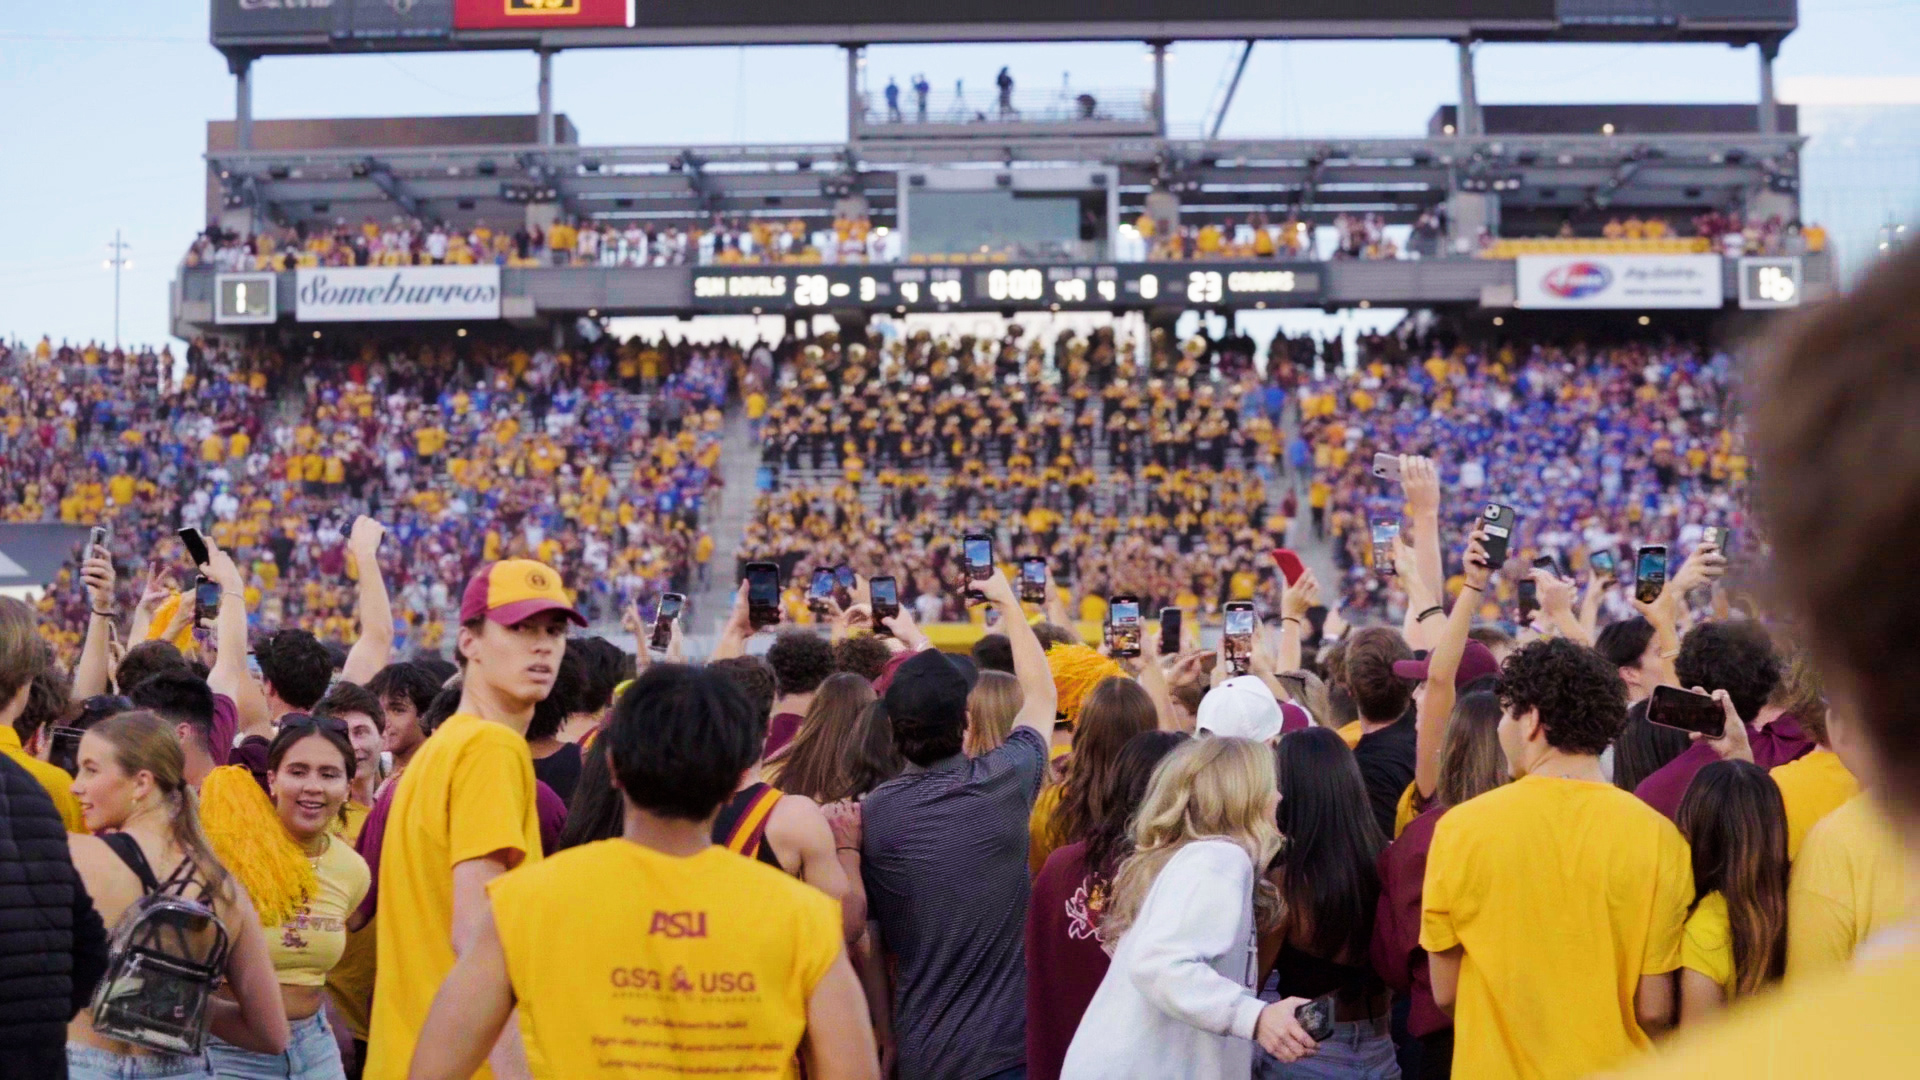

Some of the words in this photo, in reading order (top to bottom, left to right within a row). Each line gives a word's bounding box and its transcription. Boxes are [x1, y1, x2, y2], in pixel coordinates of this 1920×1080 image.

[301, 273, 498, 306] Someburros
[1187, 271, 1222, 303] 23
[648, 911, 707, 938] ASU
[700, 972, 756, 993] USG
